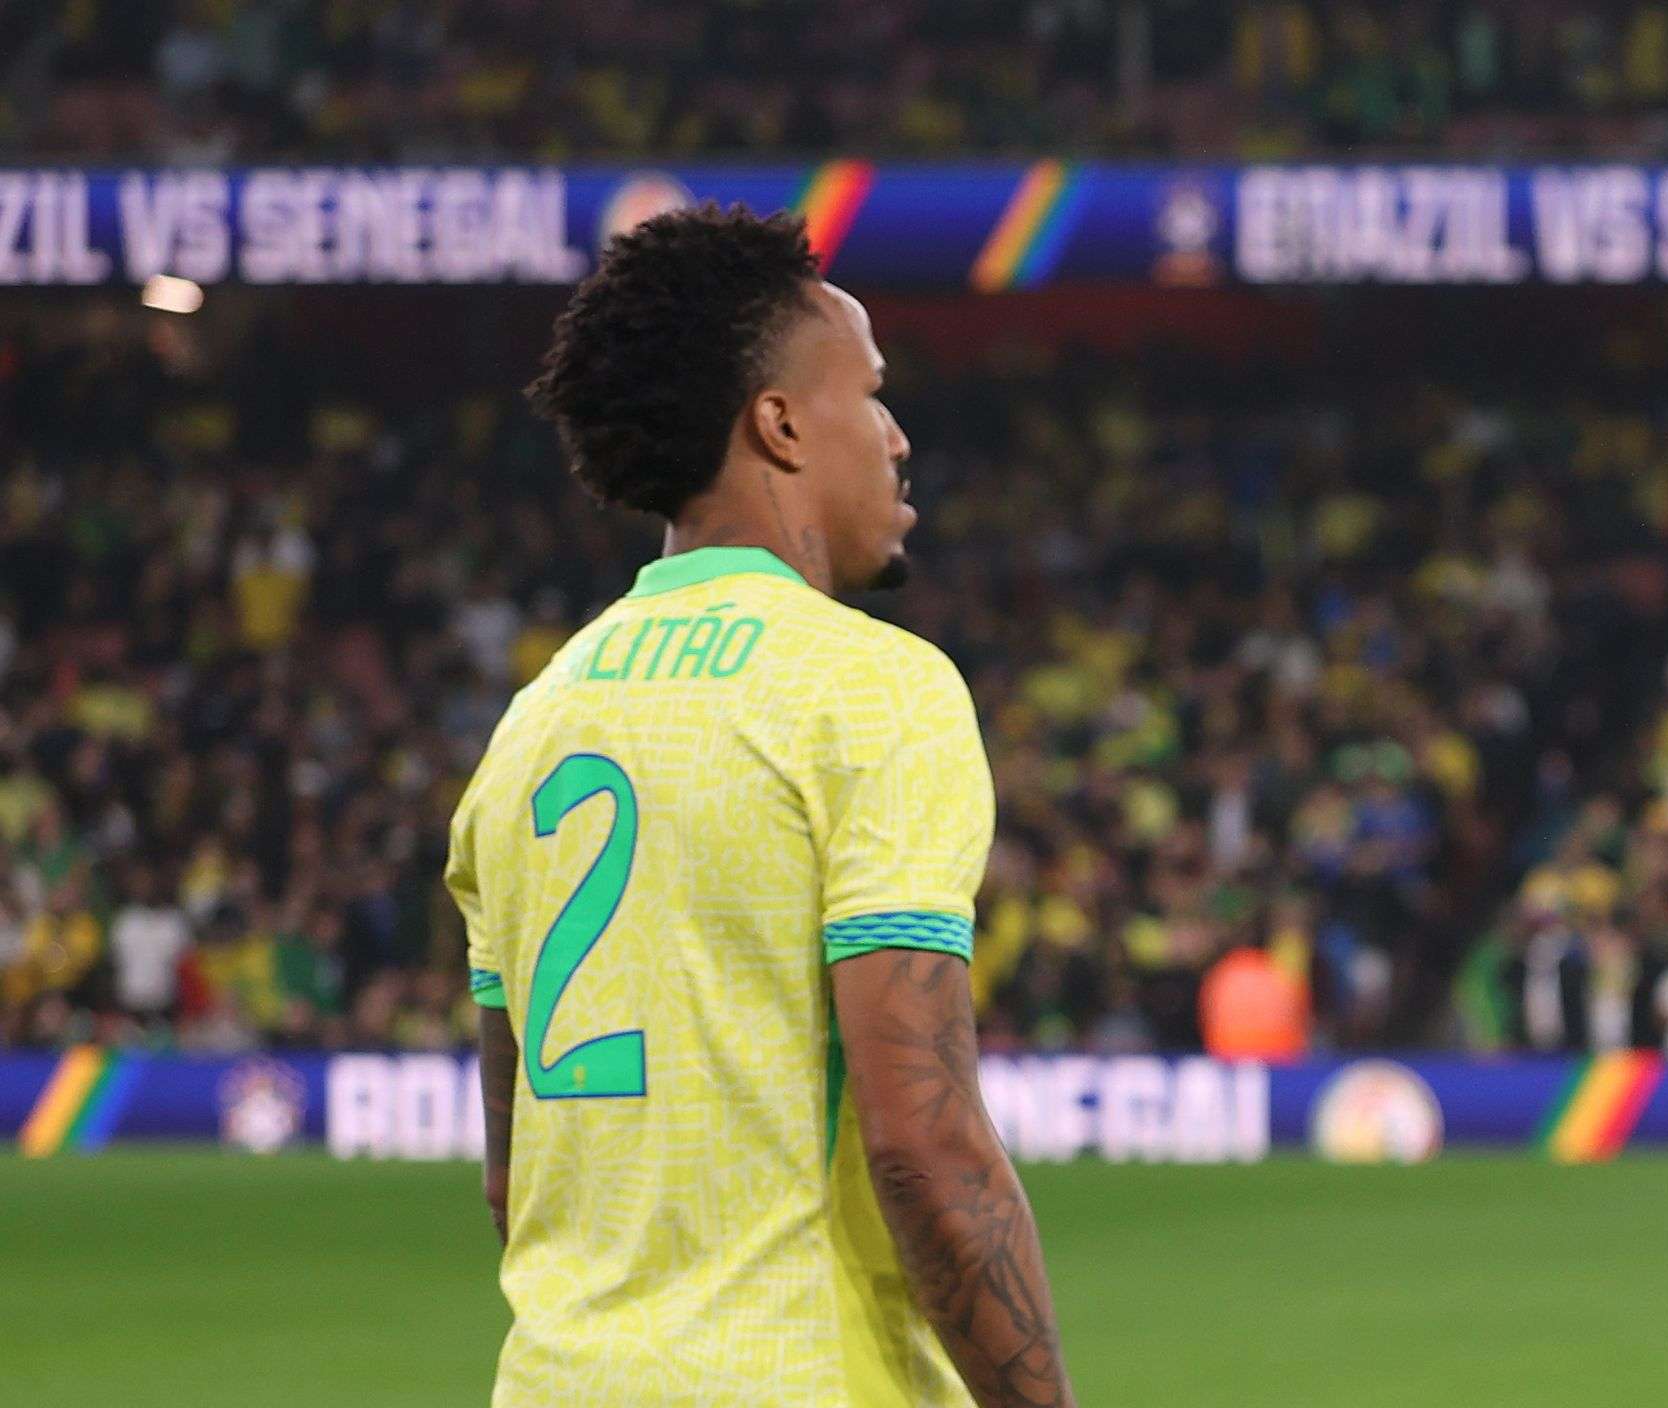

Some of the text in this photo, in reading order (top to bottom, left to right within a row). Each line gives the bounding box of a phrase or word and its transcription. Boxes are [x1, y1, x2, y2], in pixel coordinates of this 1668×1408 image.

[118, 168, 230, 284] VS
[239, 168, 590, 284] SENEGAL
[1531, 165, 1650, 282] VS
[584, 602, 766, 681] LITÃO
[524, 753, 647, 1100] 2
